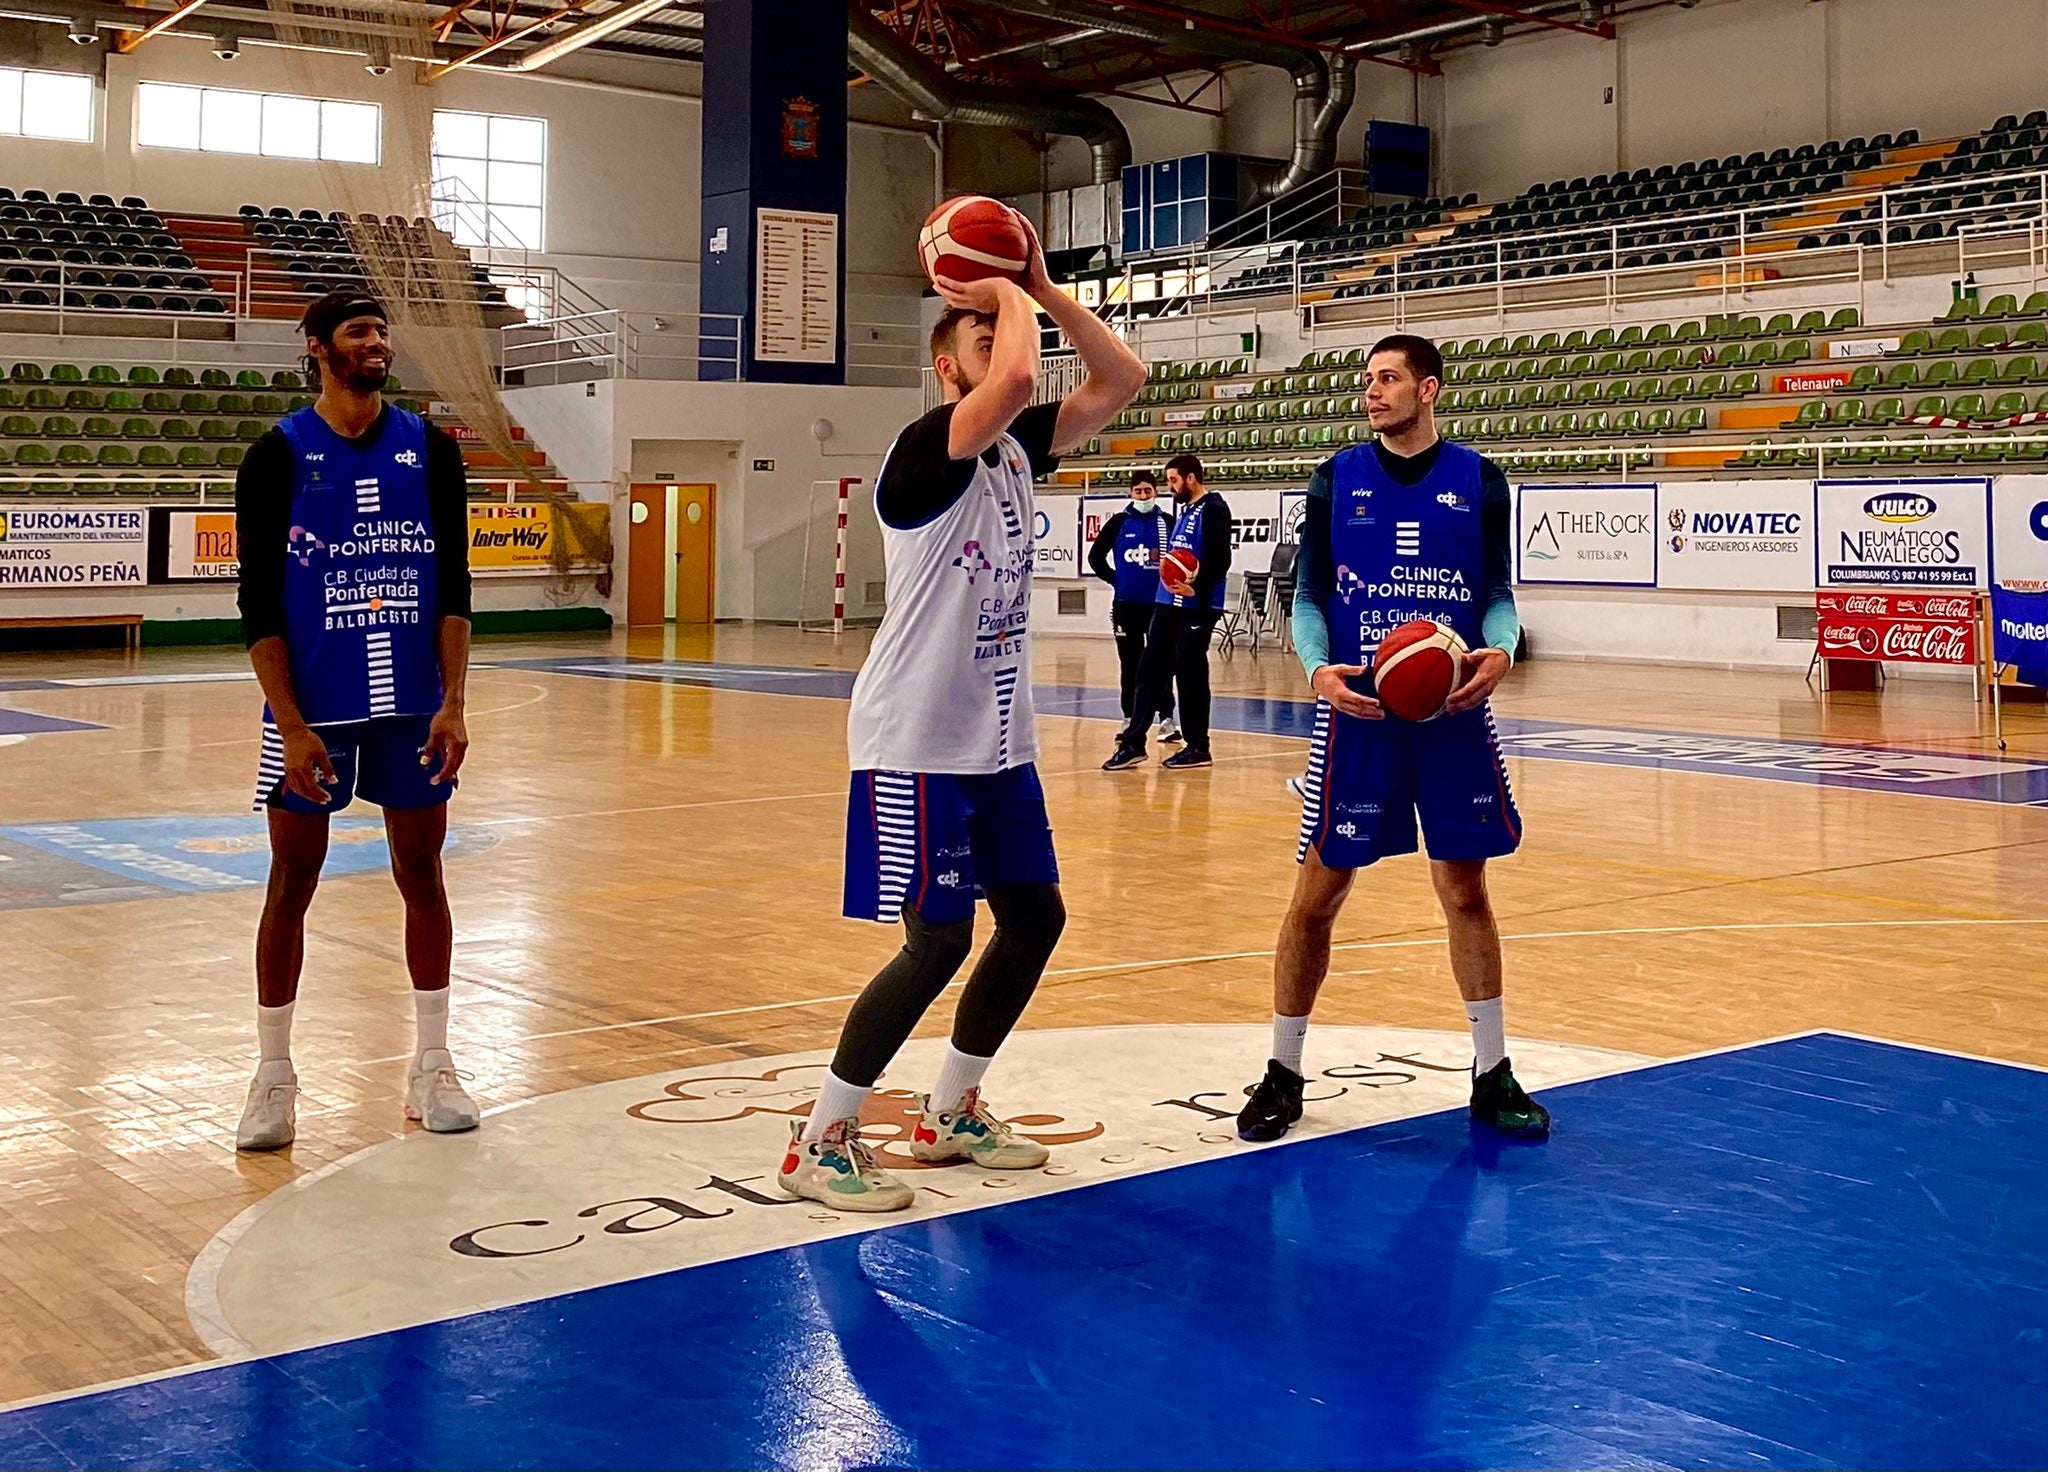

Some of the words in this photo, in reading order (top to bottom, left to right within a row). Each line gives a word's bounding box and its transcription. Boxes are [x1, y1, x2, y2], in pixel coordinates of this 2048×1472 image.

[1871, 498, 1929, 516] VULCO
[11, 513, 141, 529] EUROMASTER
[1692, 512, 1801, 534] NOVATEC
[9, 532, 81, 541] MANTENIMIENTO
[83, 531, 98, 540] DEL
[472, 522, 550, 550] InterWay
[1576, 549, 1605, 560] SUITES
[1613, 551, 1628, 560] SPA
[1694, 541, 1750, 552] INGENIEROS
[1751, 541, 1798, 553] ASESORES
[90, 561, 140, 582] PEÑA
[324, 570, 350, 586] C.B.
[401, 566, 418, 580] de
[1830, 569, 1890, 579] COLUMBRIANOS
[1901, 570, 1917, 580] 987
[1918, 571, 1928, 580] 41
[1929, 571, 1940, 580] 95
[1941, 571, 1952, 581] 99
[1953, 571, 1973, 581] Ext.1
[1368, 583, 1472, 602] PONFERRAD
[325, 611, 418, 630] BALONCESTO
[1360, 610, 1384, 624] C.B.
[1436, 612, 1452, 626] de
[1883, 623, 1969, 660] Coca-Cola
